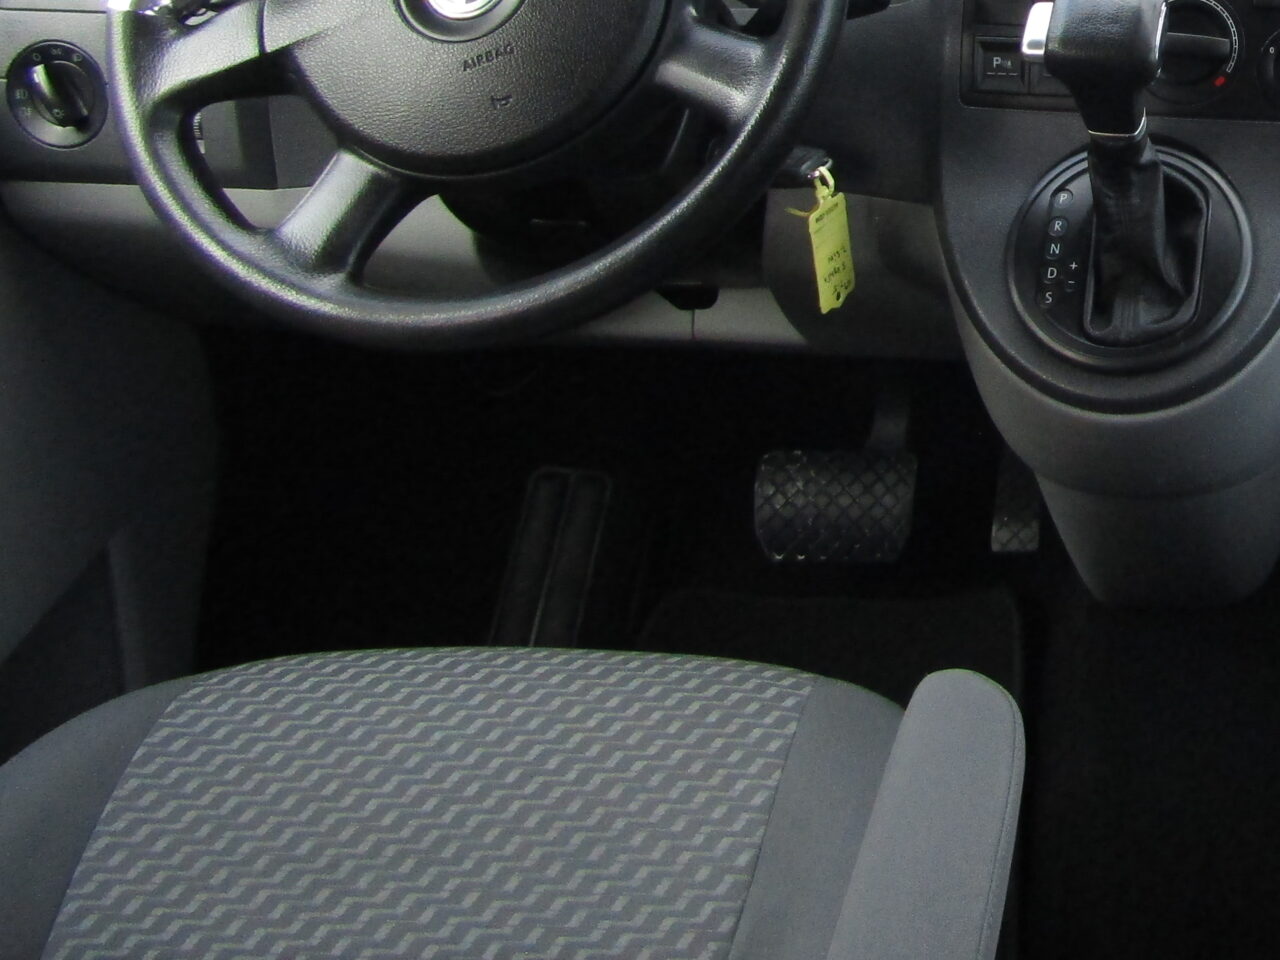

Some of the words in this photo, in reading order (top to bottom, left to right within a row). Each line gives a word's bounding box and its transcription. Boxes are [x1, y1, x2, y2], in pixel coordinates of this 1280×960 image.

[462, 44, 516, 72] AIRBAG
[1059, 193, 1068, 204] P
[1054, 220, 1062, 231] R
[1050, 243, 1060, 254] N
[1047, 267, 1057, 279] D
[1045, 291, 1053, 303] S
